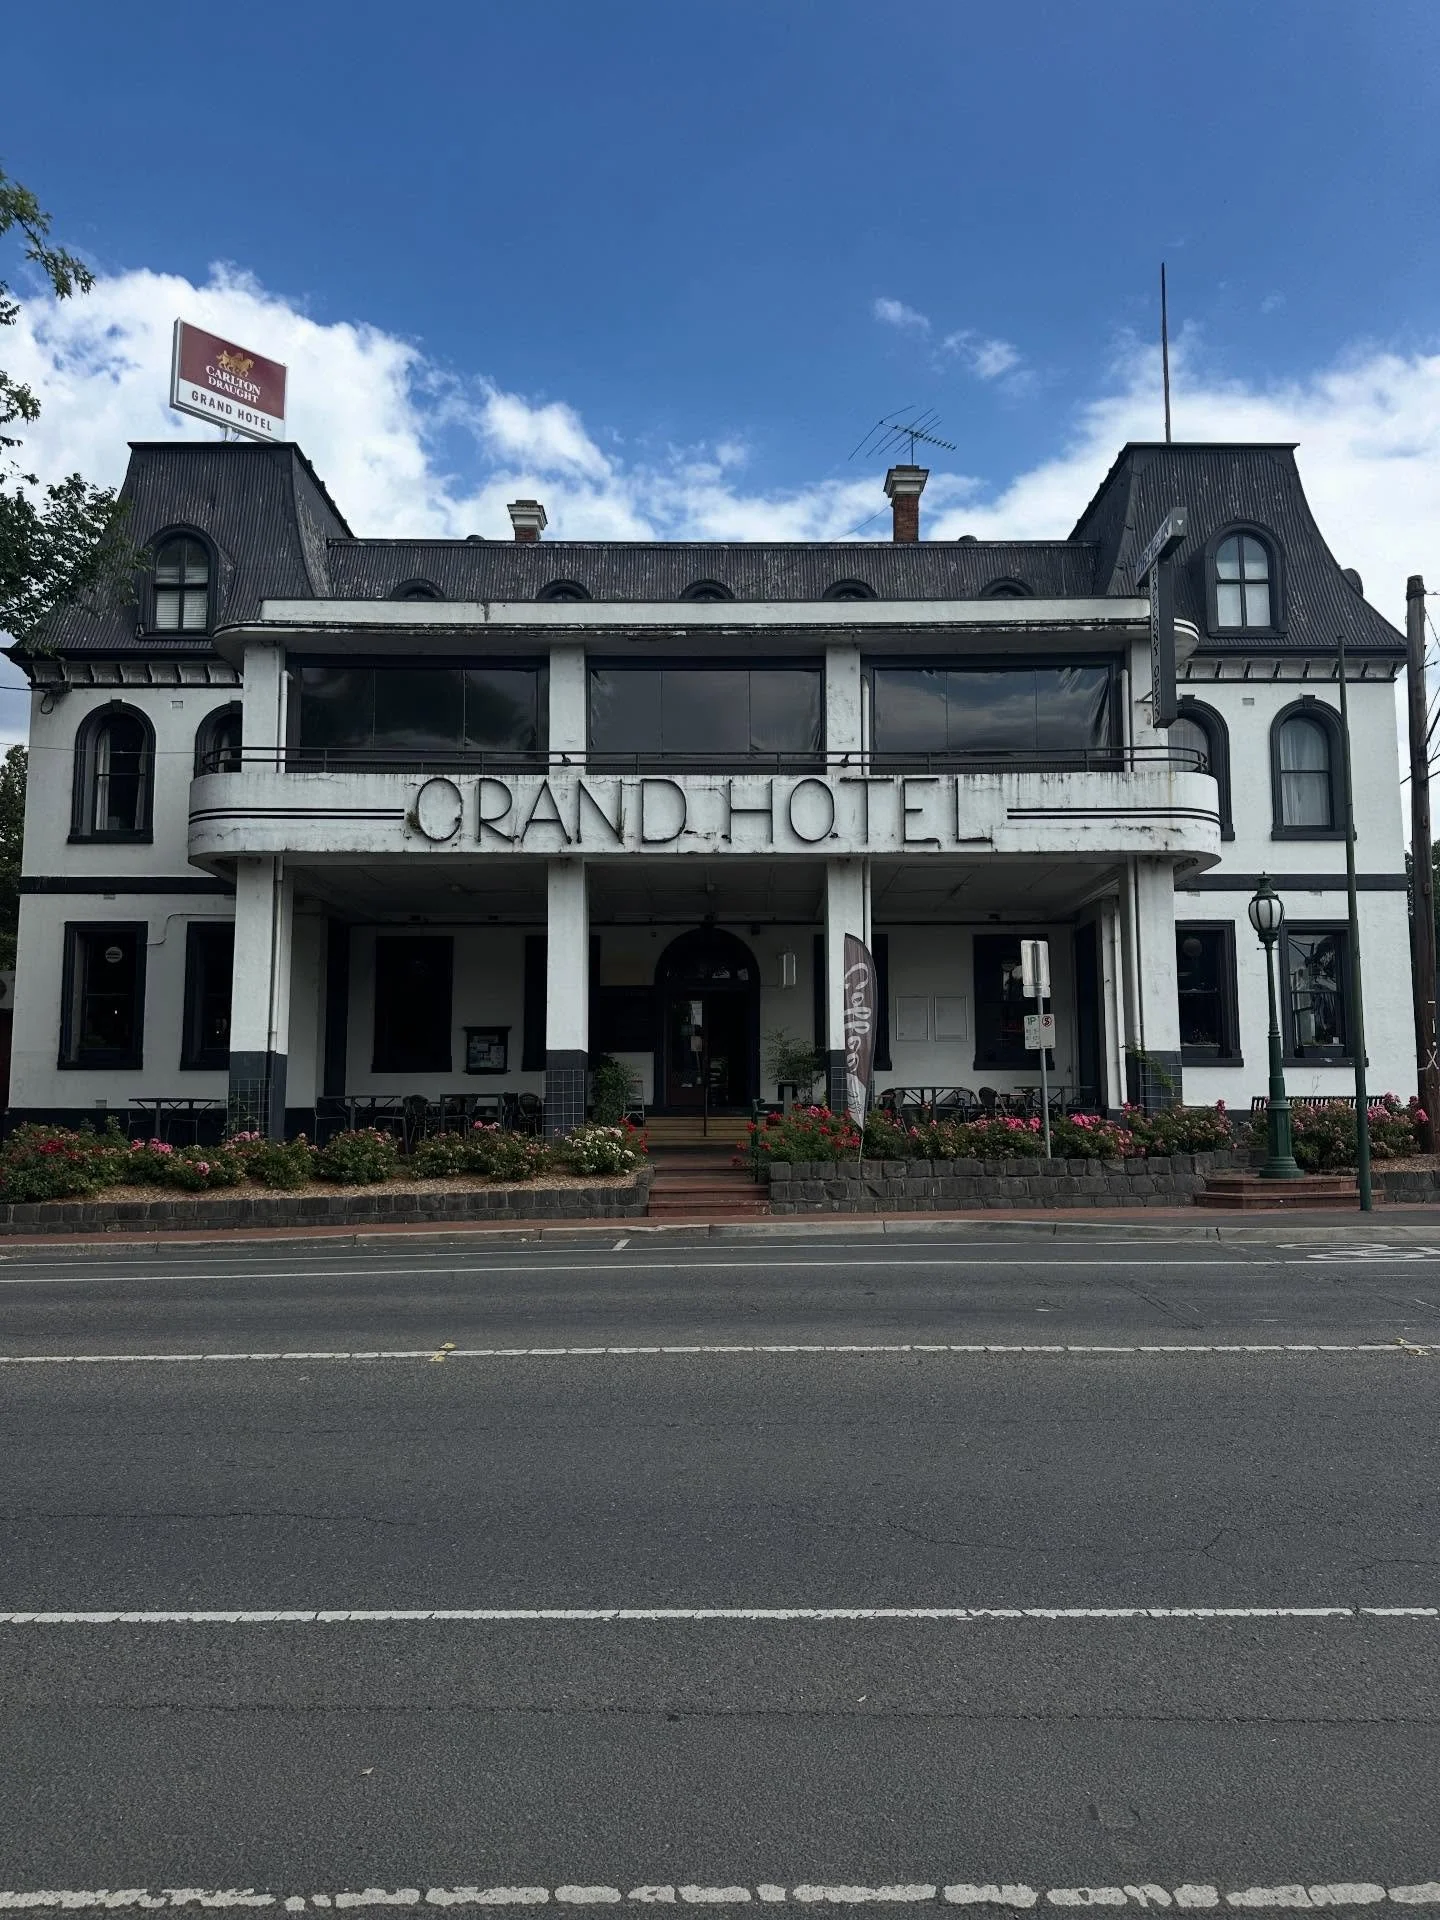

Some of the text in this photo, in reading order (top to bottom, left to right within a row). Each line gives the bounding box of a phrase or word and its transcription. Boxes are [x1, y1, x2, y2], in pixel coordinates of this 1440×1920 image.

[205, 365, 261, 396] CARLTON
[208, 376, 259, 404] DRAUGHT
[191, 390, 272, 432] GRAND HOTEL
[416, 777, 993, 844] GRAND HOTEL
[844, 962, 872, 1073] Coffee
